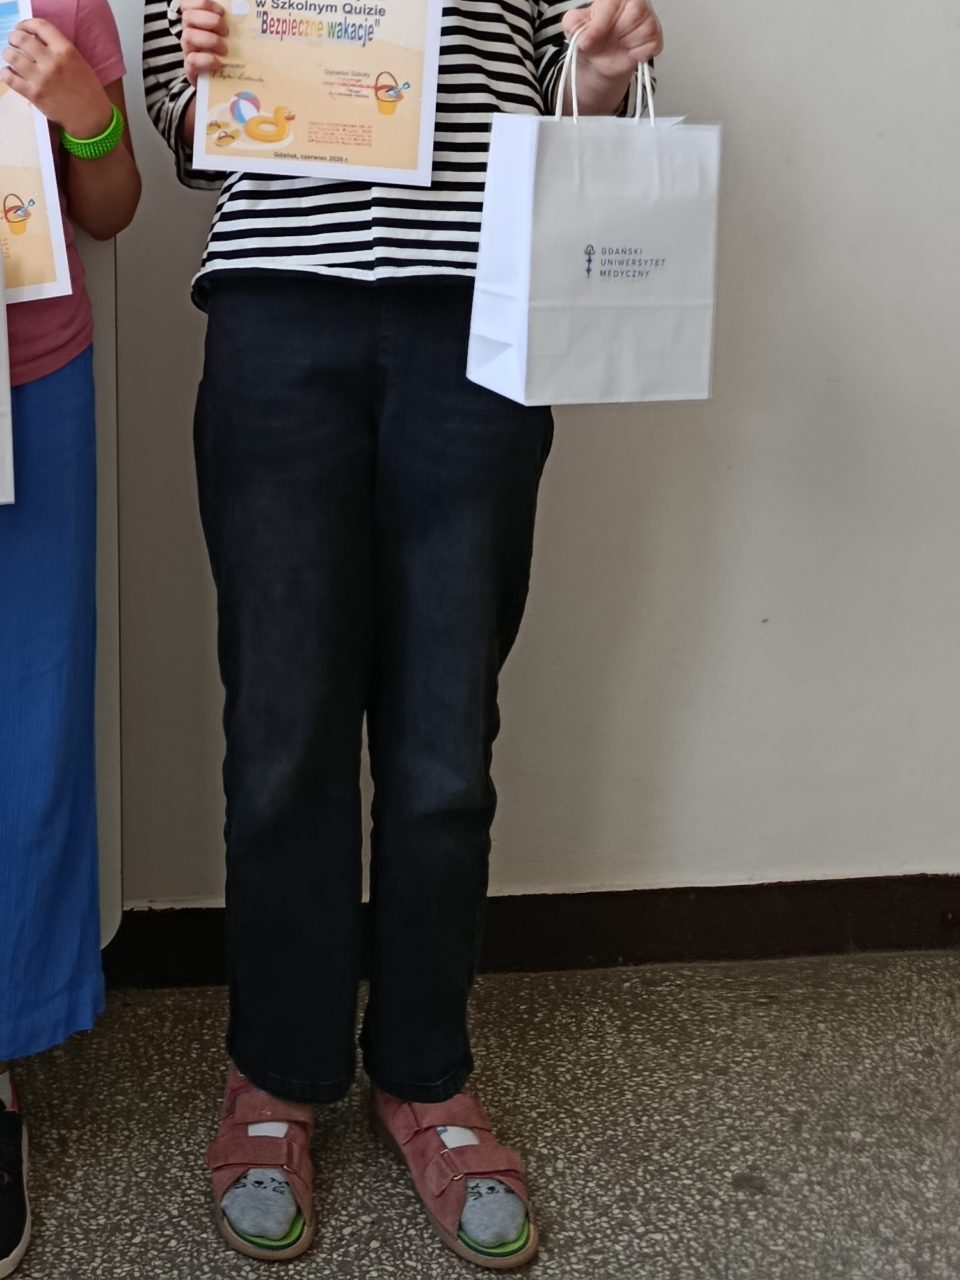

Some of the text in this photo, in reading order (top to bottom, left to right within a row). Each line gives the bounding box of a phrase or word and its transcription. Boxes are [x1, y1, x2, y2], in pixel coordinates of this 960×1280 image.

[256, 0, 266, 8] w
[343, 2, 386, 17] Quizie
[256, 10, 380, 47] "Bezpieczne wakacje"
[600, 270, 650, 278] MEDYCZNY
